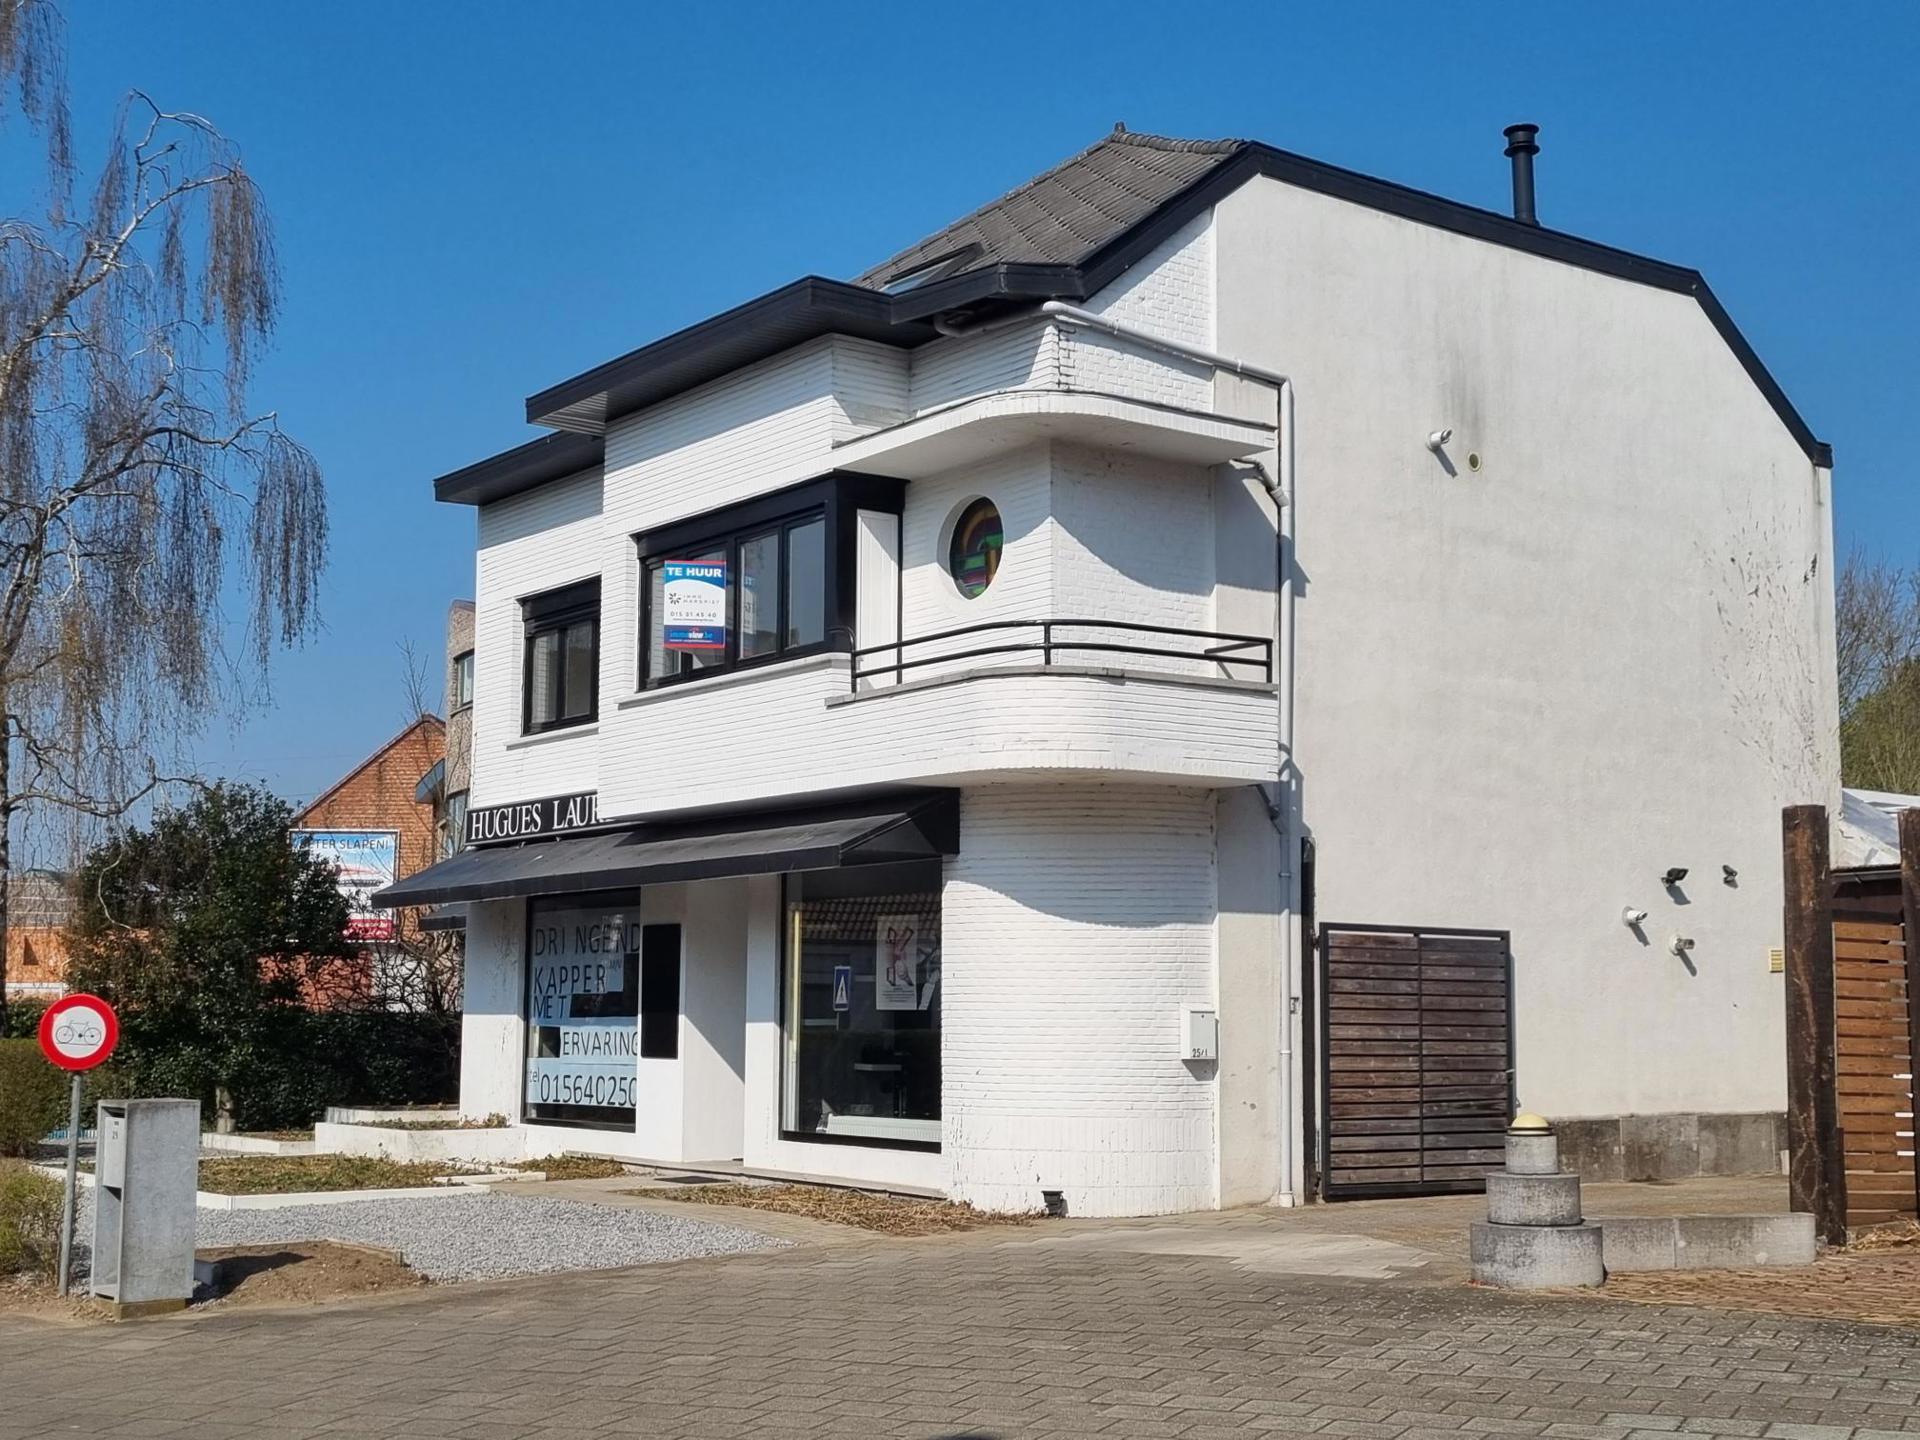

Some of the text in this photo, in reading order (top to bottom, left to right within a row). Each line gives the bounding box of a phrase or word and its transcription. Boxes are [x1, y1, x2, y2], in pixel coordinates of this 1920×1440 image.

[666, 567, 722, 578] TE HUUR
[470, 793, 606, 840] HUGUES LAUR
[534, 964, 606, 994] KAPPER
[533, 995, 567, 1019] MET
[562, 1031, 637, 1056] ERVARING
